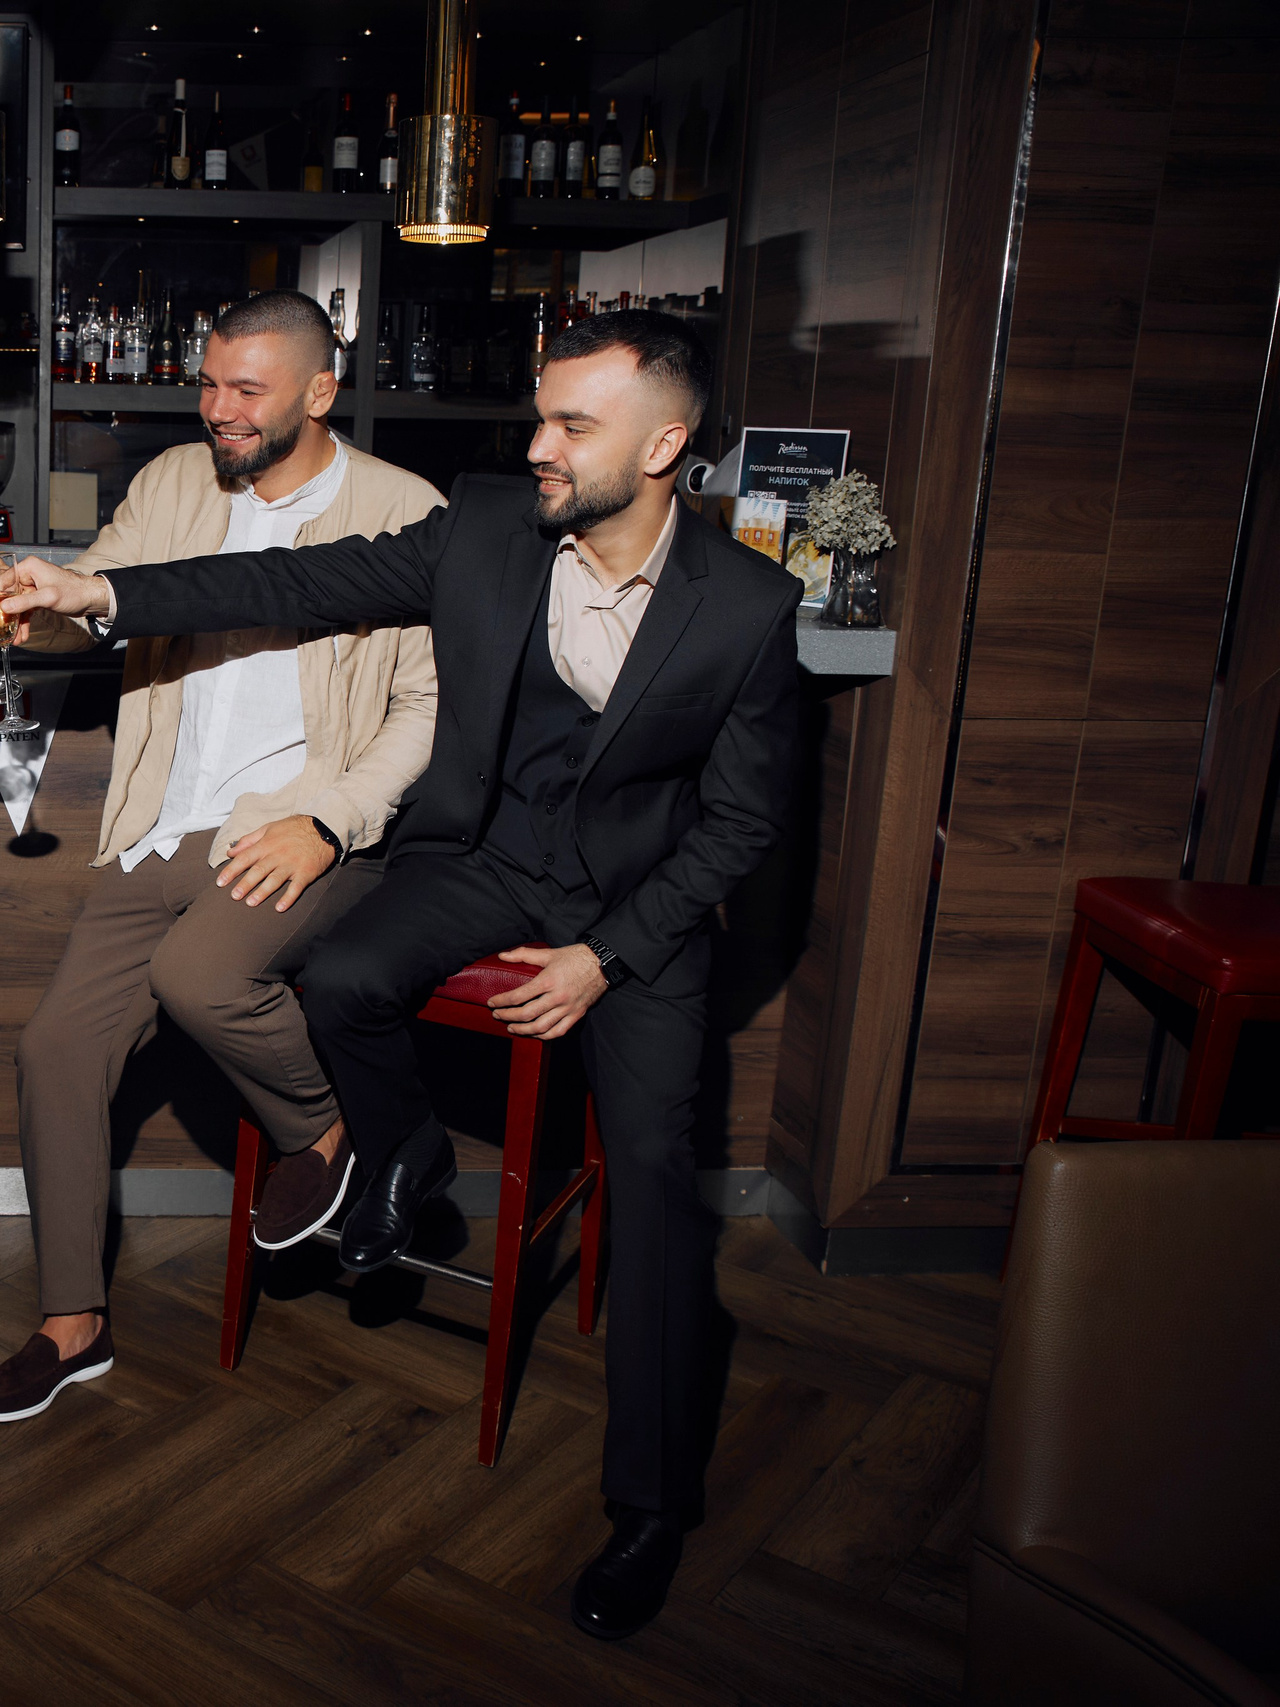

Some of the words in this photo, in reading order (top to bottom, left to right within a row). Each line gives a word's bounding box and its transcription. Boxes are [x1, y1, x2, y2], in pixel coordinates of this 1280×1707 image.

[749, 464, 785, 473] ПОЛУЧИТЕ
[786, 466, 834, 475] БЕСПЛАТНЫЙ
[768, 476, 810, 486] НАПИТОК
